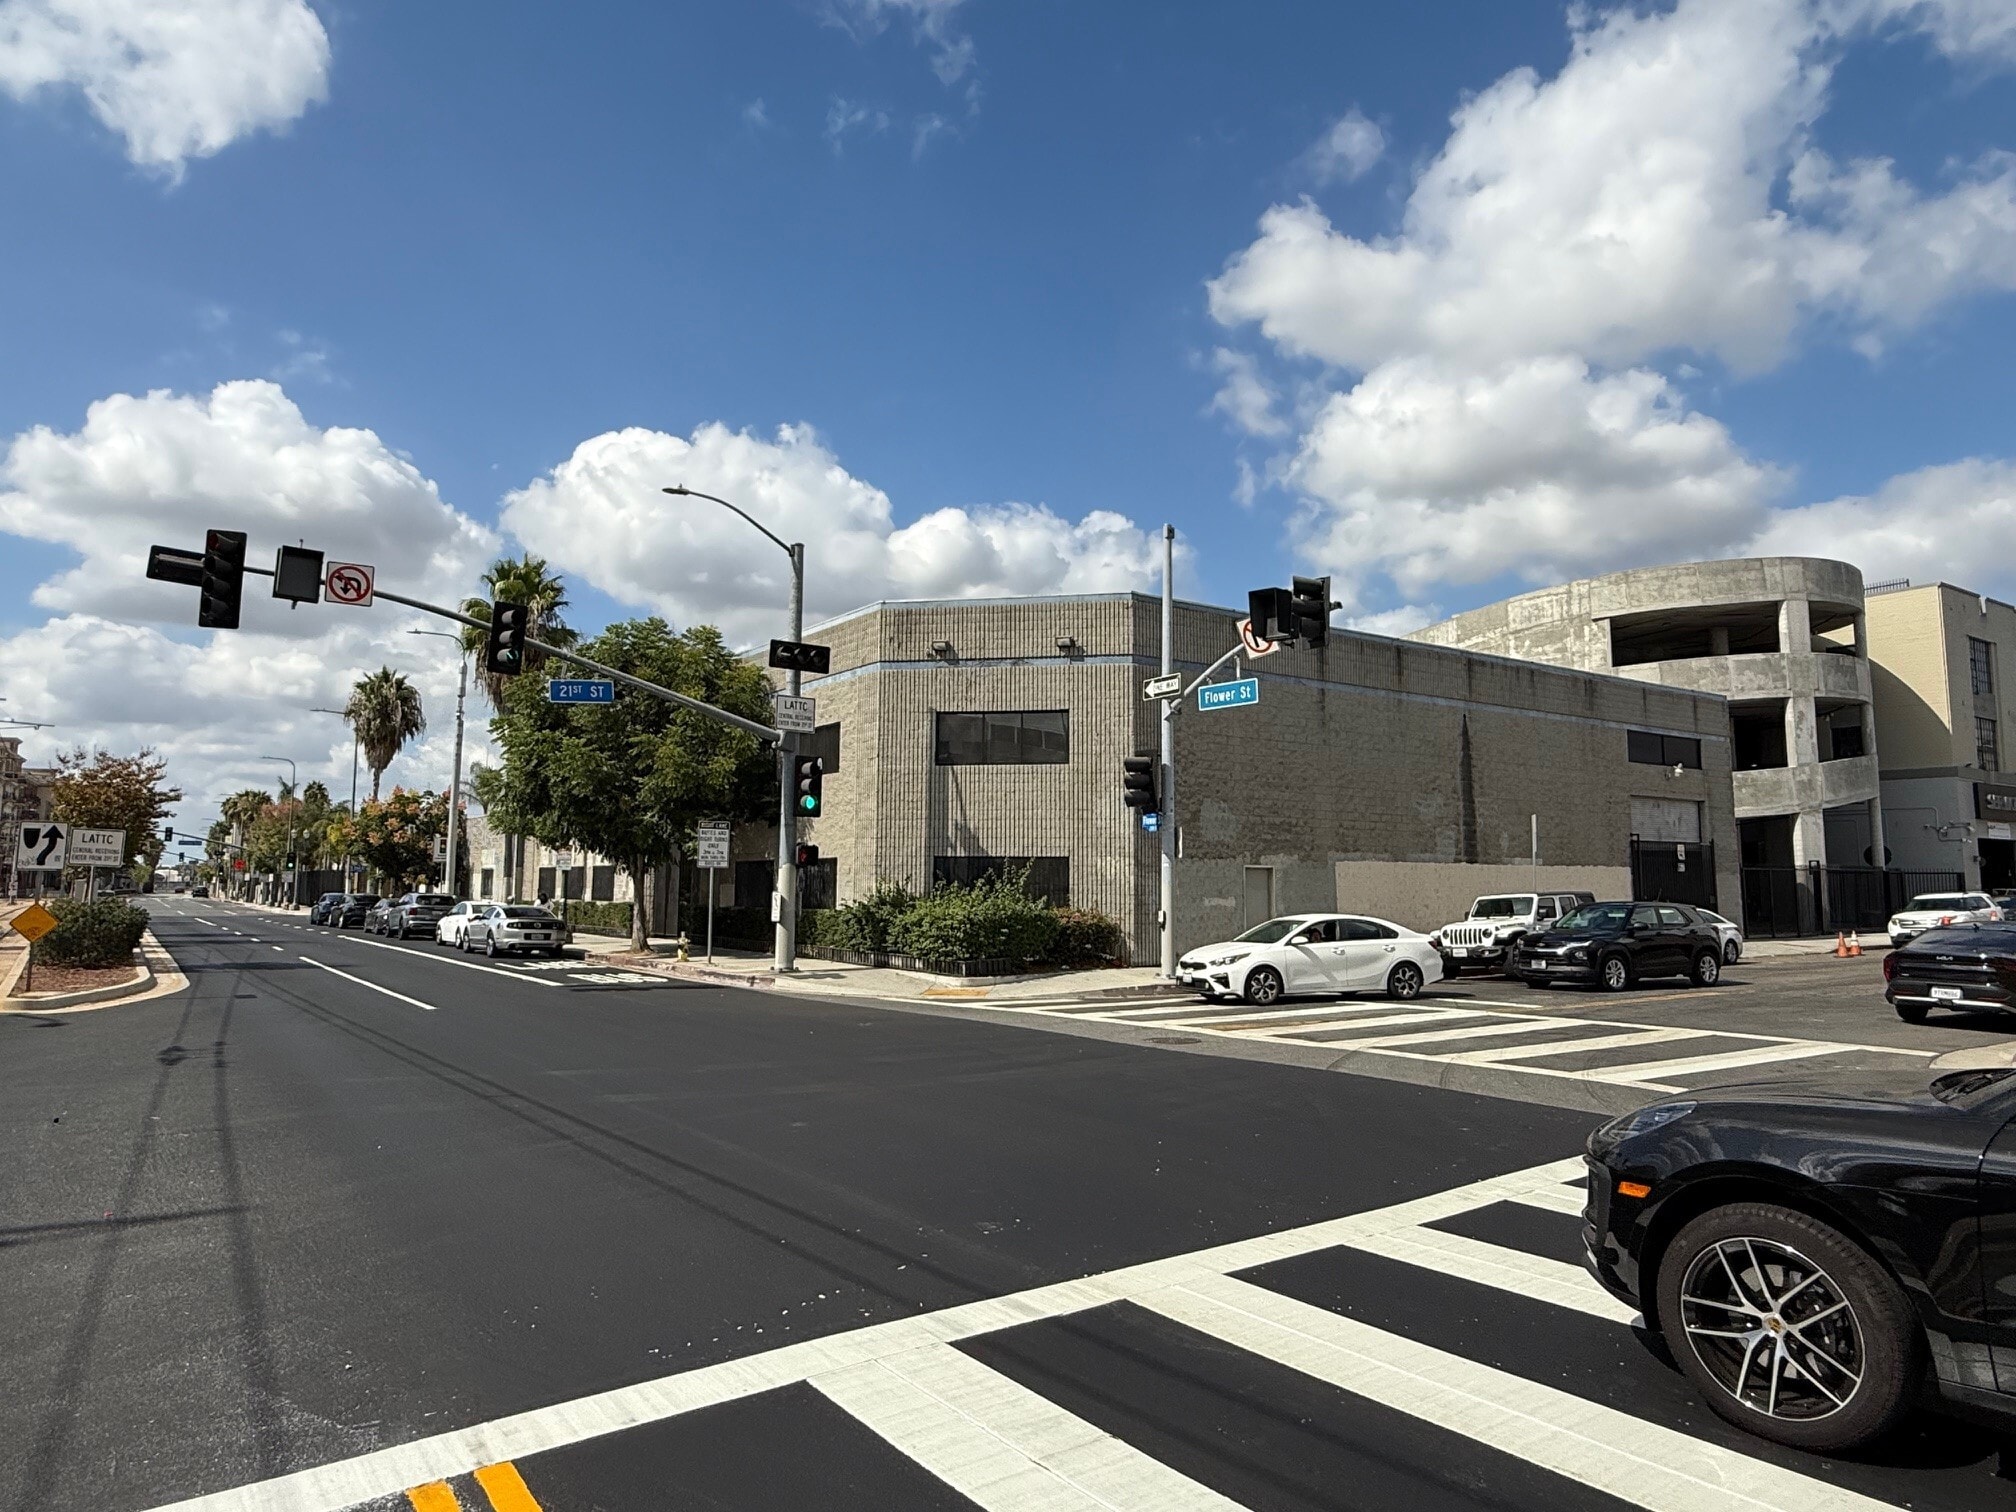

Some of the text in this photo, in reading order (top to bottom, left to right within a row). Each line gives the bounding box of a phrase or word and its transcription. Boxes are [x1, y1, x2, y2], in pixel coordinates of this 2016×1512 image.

[560, 685, 604, 697] 21ST ST
[1153, 680, 1177, 692] ONE WAY
[1205, 685, 1251, 704] Flower St
[784, 700, 808, 712] LATTC
[82, 833, 114, 845] LATTC
